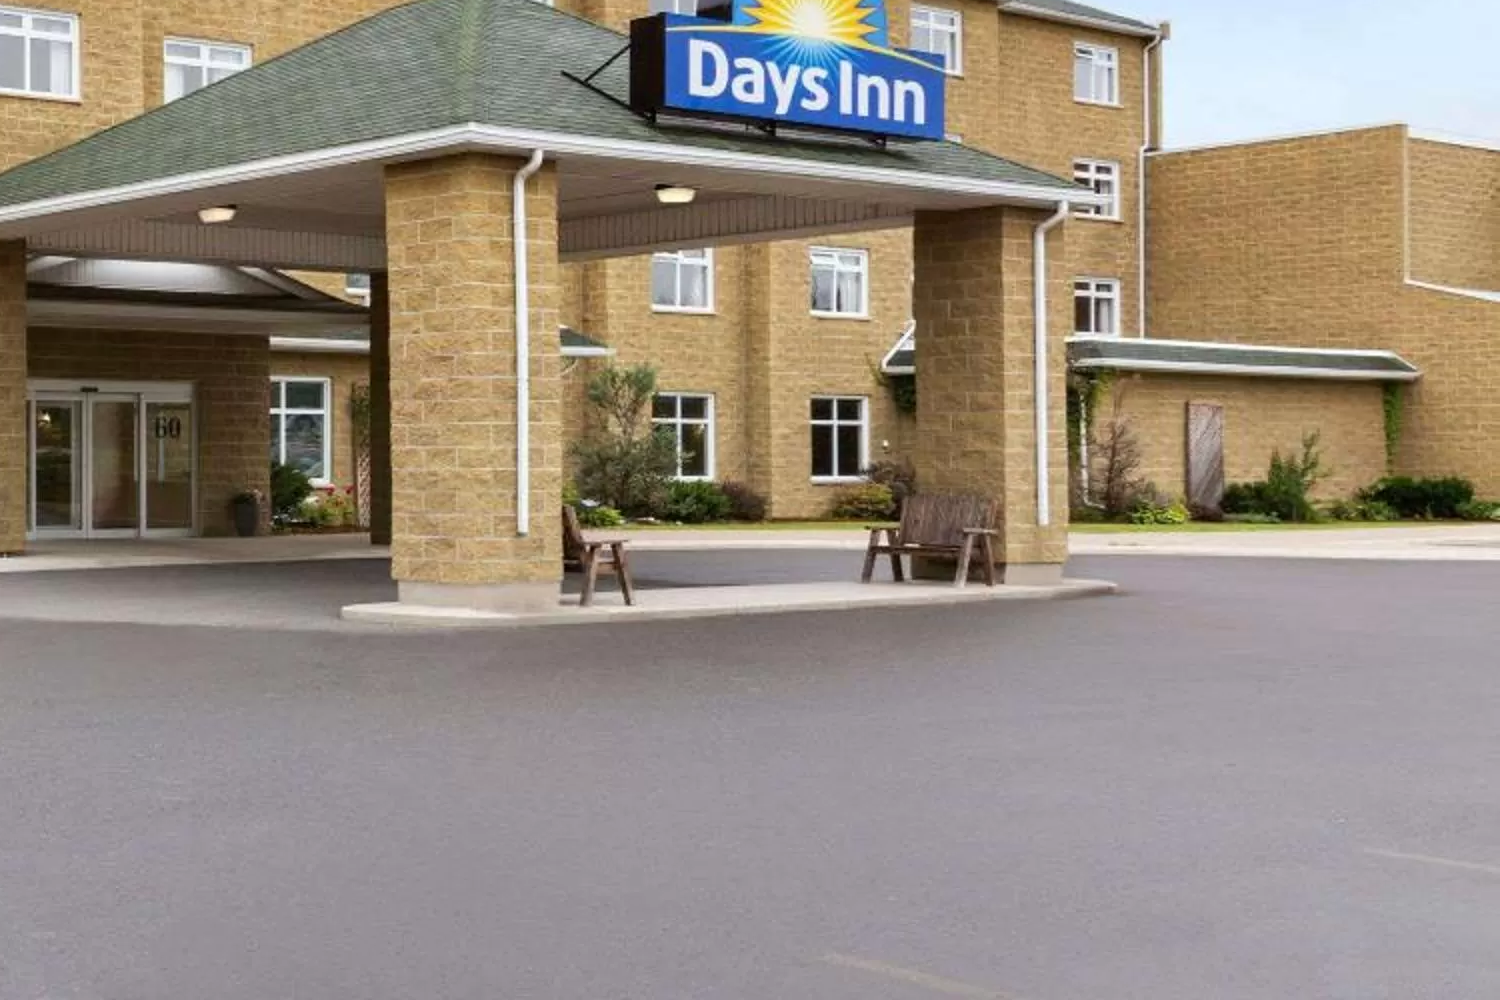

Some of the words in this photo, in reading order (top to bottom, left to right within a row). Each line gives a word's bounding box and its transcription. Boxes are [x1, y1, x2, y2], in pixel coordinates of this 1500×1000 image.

[687, 38, 830, 115] Days
[838, 59, 926, 125] Inn
[155, 414, 182, 439] 60
